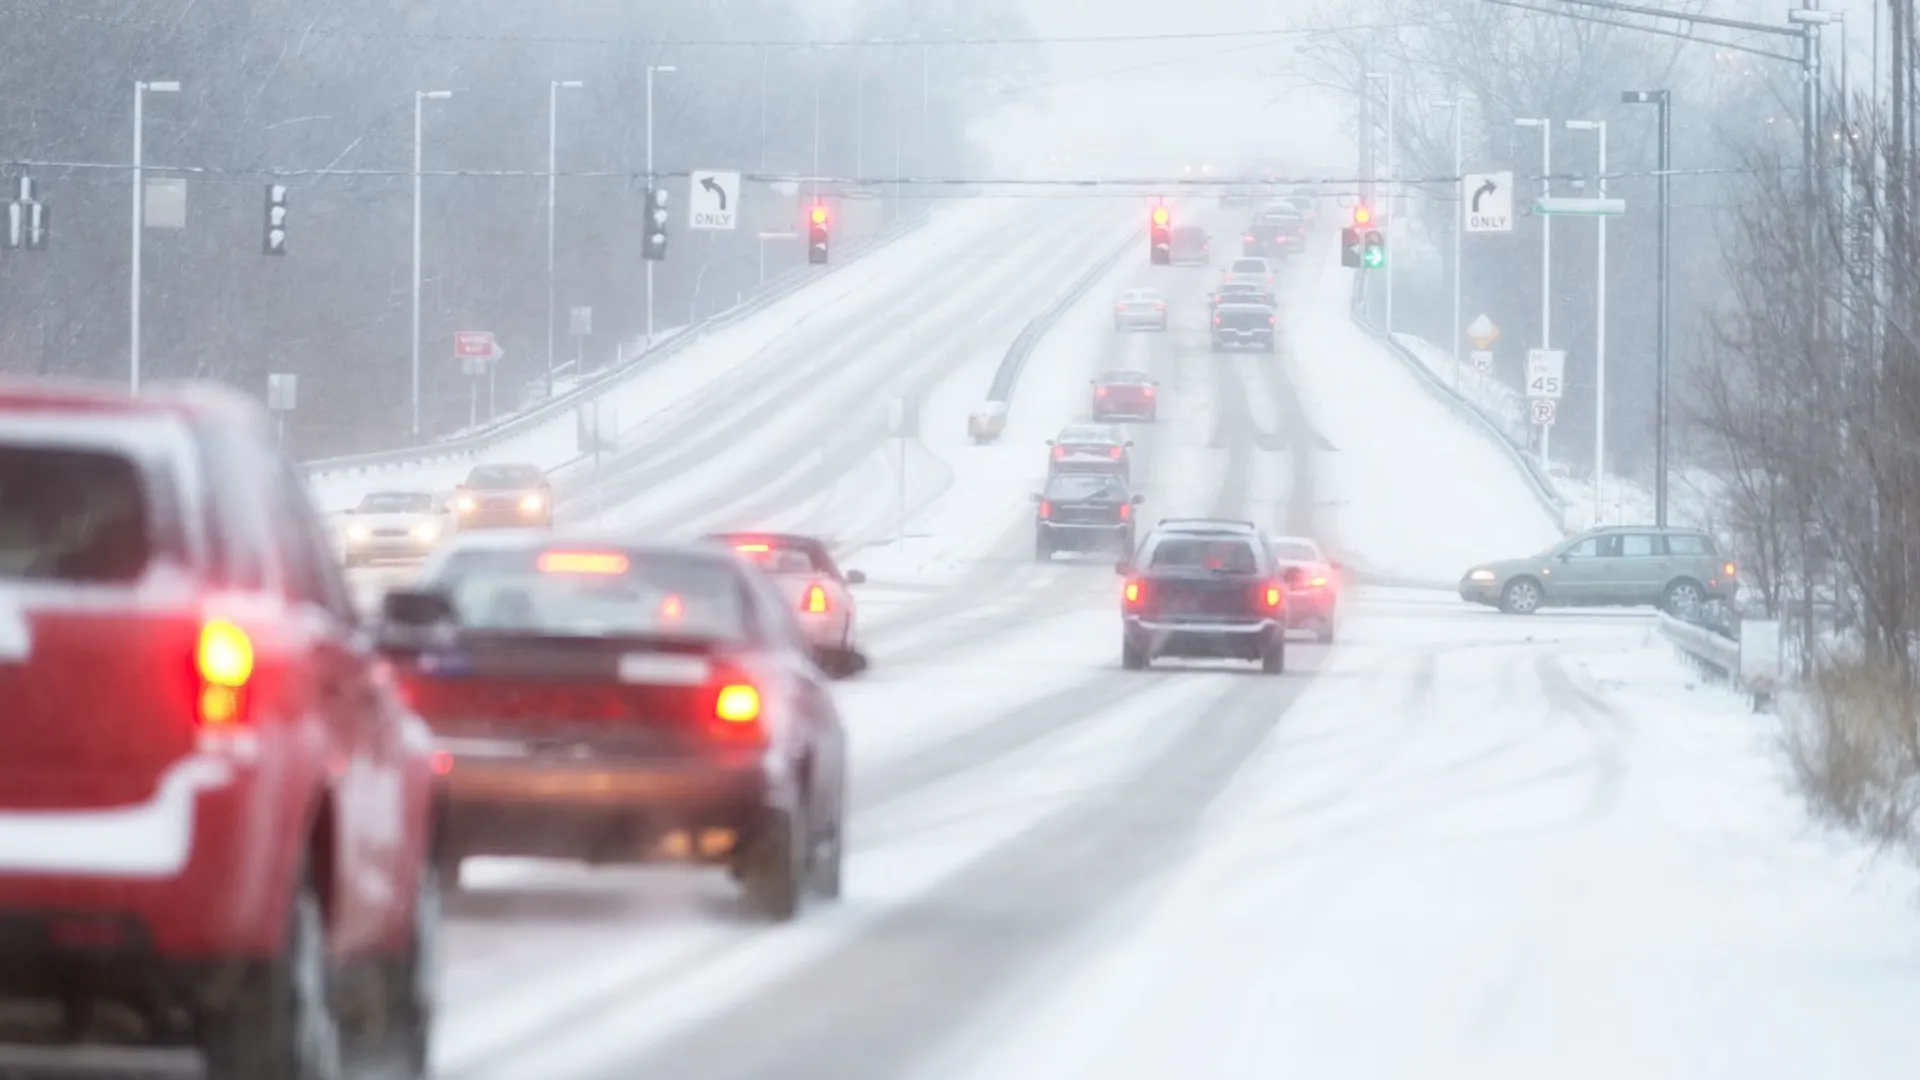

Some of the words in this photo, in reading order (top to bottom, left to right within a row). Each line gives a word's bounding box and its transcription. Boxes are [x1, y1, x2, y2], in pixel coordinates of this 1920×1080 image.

[695, 212, 731, 226] ONLY
[1471, 215, 1507, 229] ONLY
[1531, 377, 1559, 393] 45
